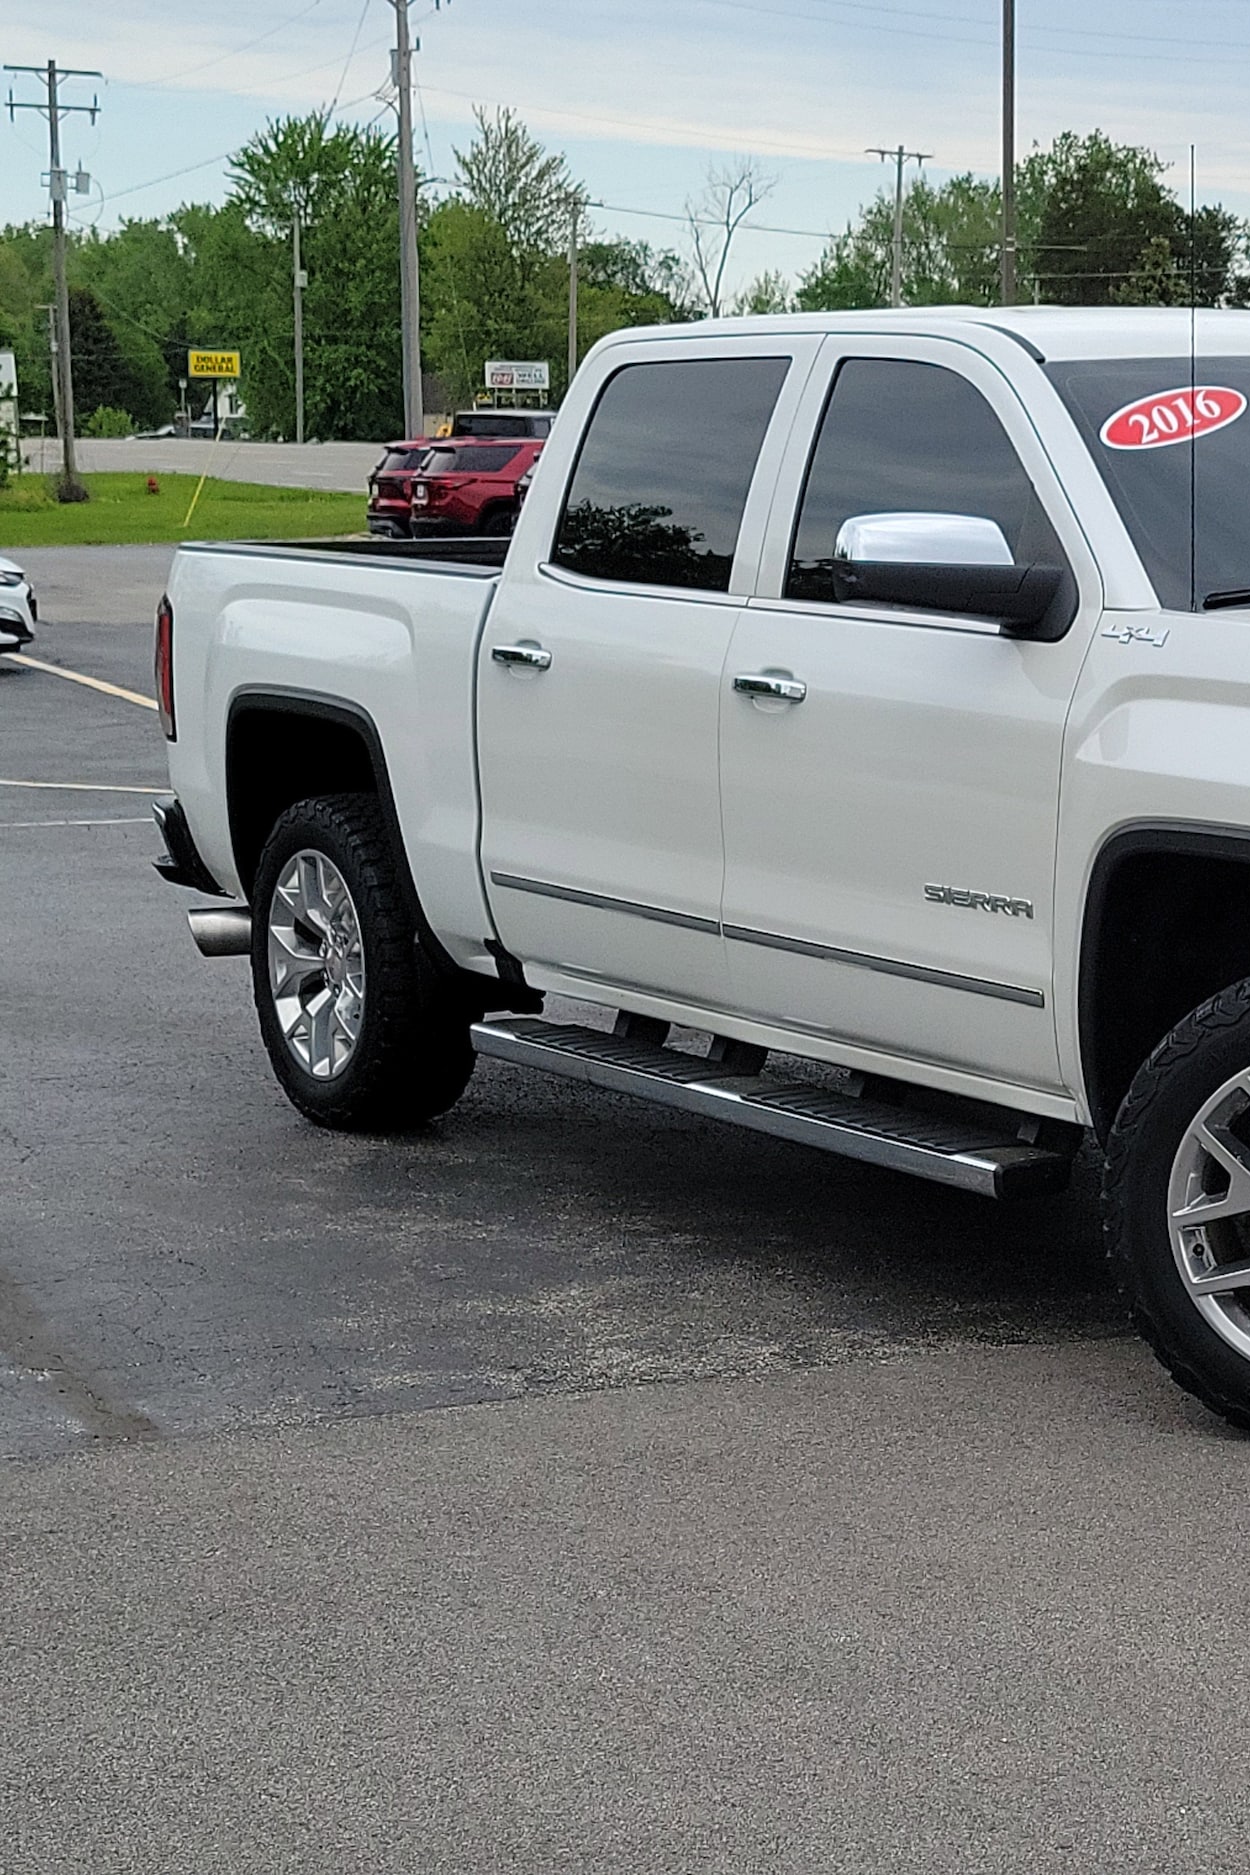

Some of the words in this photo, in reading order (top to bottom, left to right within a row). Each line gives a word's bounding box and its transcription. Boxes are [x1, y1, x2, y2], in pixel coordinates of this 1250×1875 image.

[194, 364, 234, 372] GENERAL
[196, 355, 233, 363] DOLLAR
[1128, 390, 1221, 444] 2016
[924, 883, 1034, 920] SIERRA
